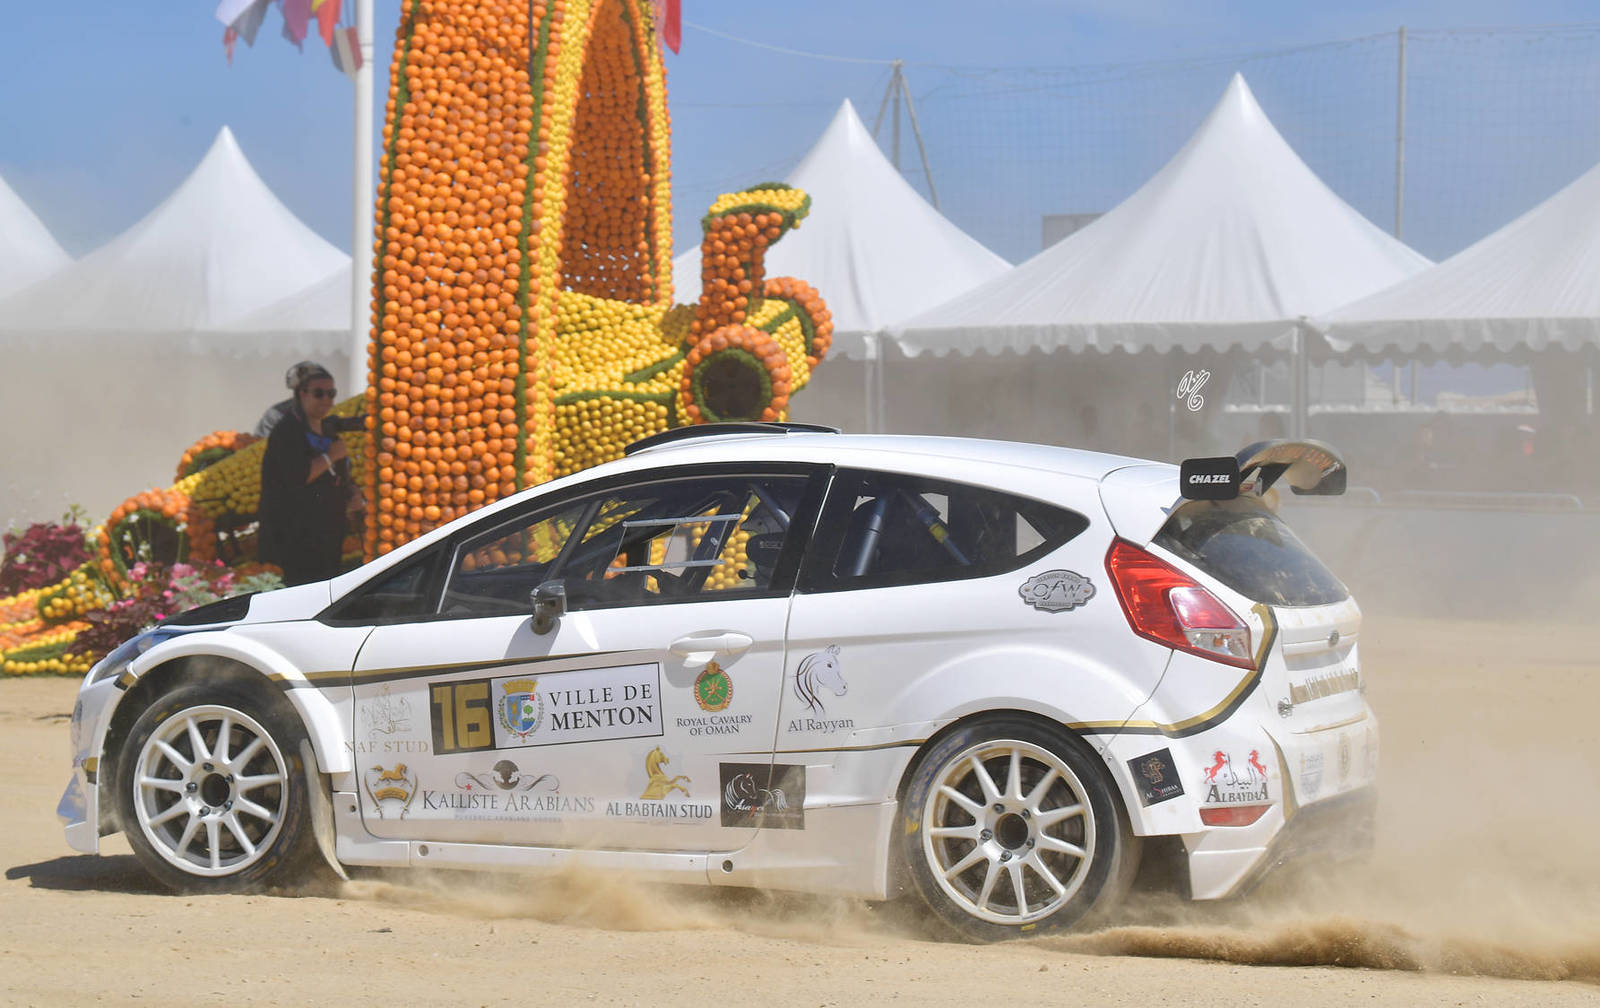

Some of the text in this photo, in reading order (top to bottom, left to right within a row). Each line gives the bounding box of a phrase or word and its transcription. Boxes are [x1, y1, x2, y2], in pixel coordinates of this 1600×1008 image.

[1189, 474, 1231, 484] CHAZEL
[549, 683, 653, 707] VILLE DE
[433, 683, 492, 750] 16
[551, 705, 654, 731] MENTON
[676, 714, 752, 727] ROYAL CAVALRY
[689, 725, 739, 736] OF OMAN
[788, 717, 854, 733] Al Rayyan
[384, 740, 429, 753] STUD
[423, 790, 499, 811] KALLISTE
[504, 791, 595, 813] ARABIANS
[606, 802, 713, 818] AL BABTAIN STUD
